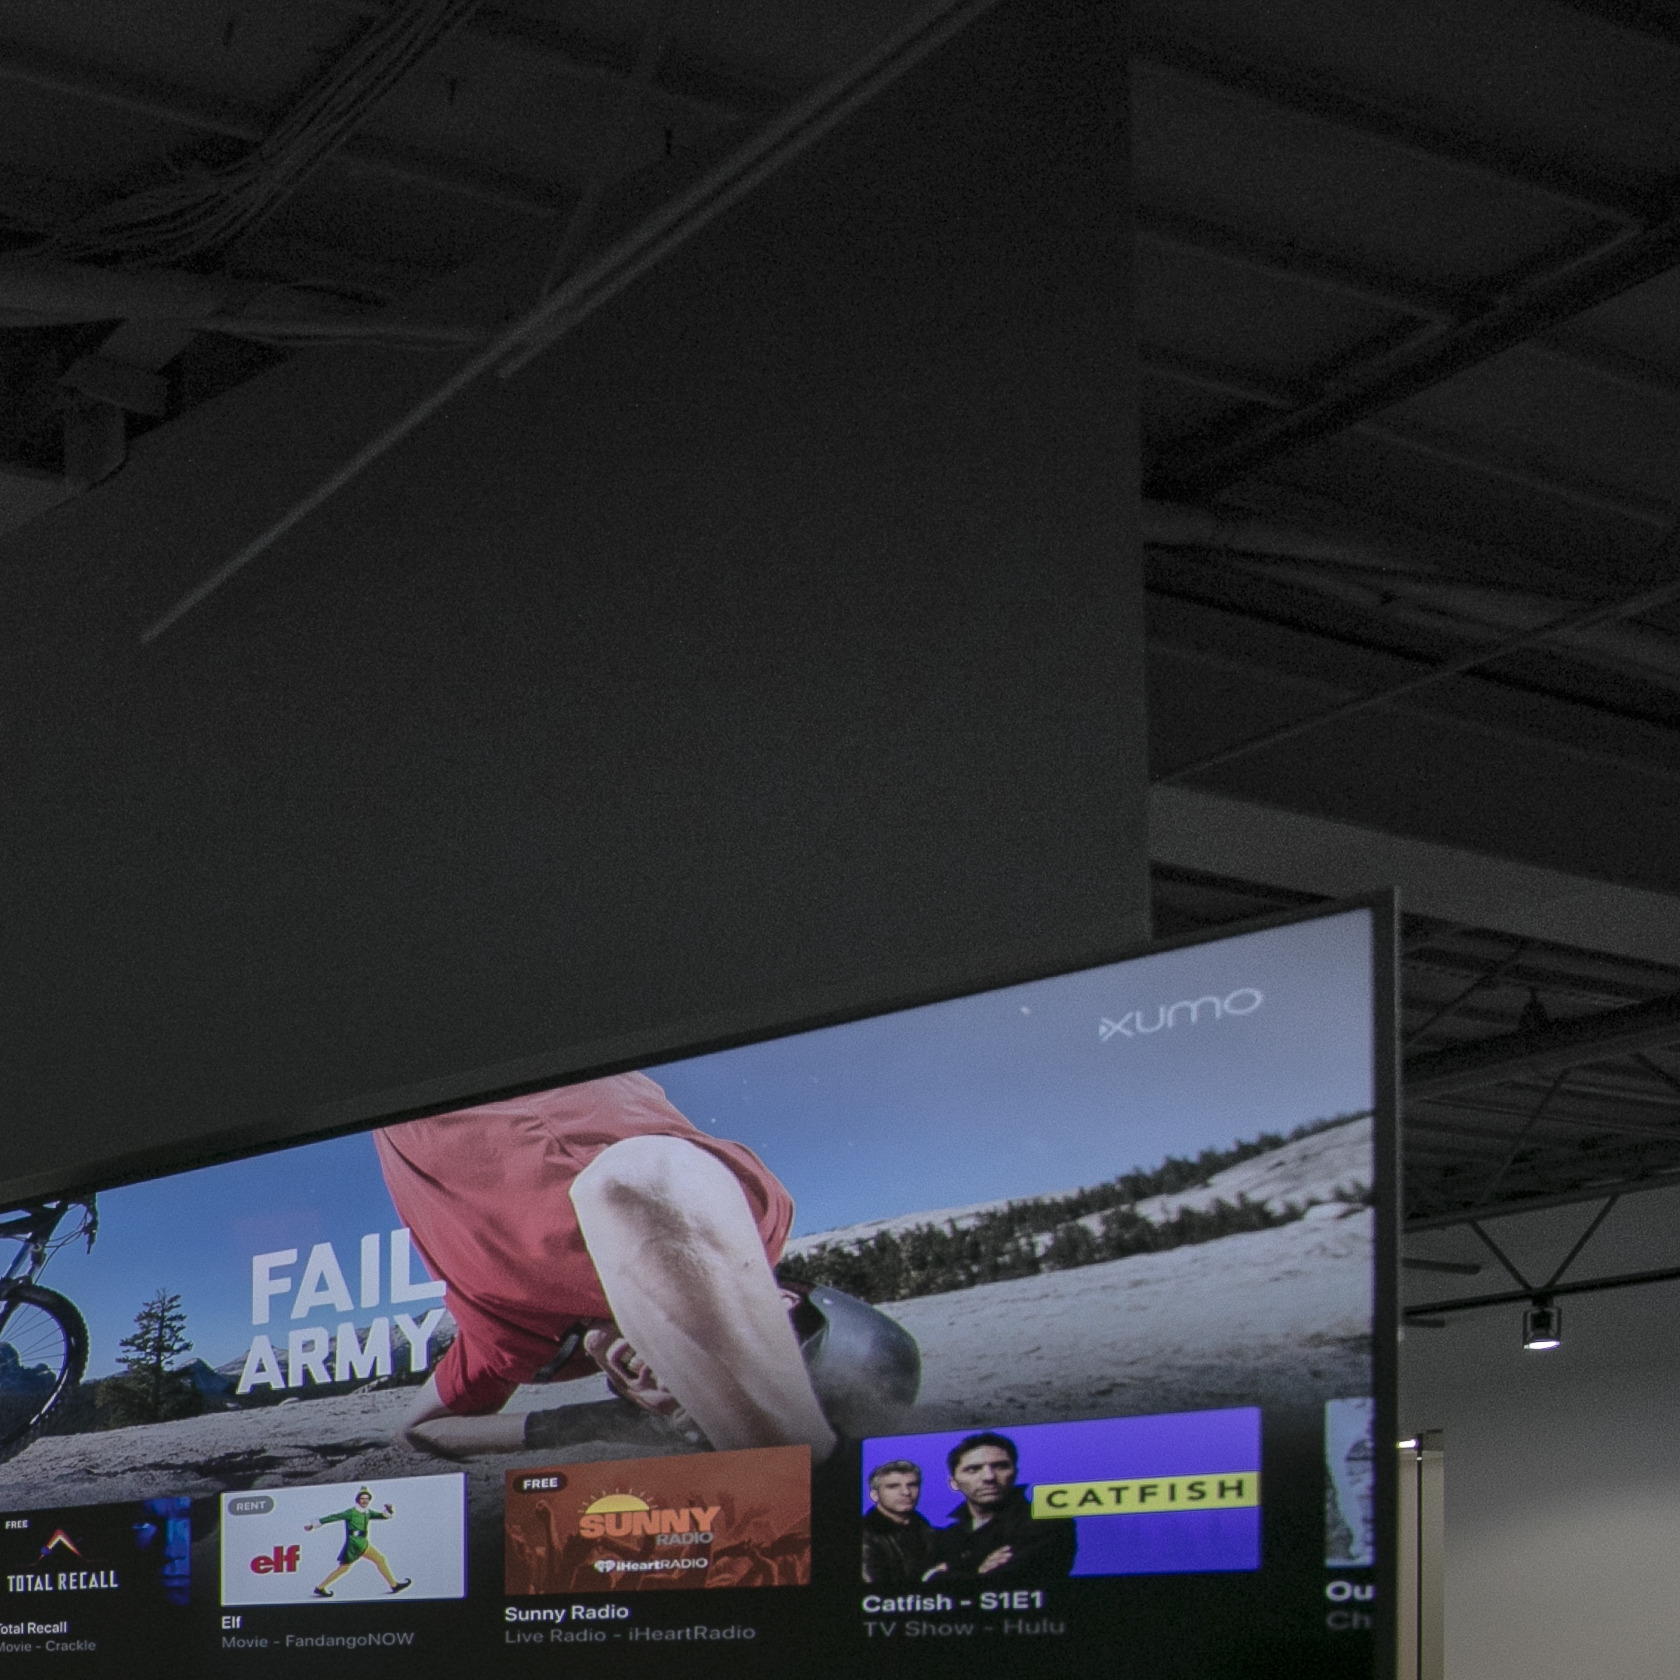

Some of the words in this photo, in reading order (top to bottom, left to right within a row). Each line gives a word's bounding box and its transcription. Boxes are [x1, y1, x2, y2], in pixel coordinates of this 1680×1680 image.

[252, 1227, 447, 1326] FAIL
[235, 1308, 446, 1396] ARMY
[523, 1477, 559, 1491] FREE
[1045, 1478, 1245, 1510] CATFISH
[236, 1500, 267, 1512] RENT
[5, 1519, 29, 1530] FREE
[579, 1505, 722, 1539] SUNNY
[656, 1531, 715, 1547] RADIO
[250, 1545, 301, 1575] elf
[616, 1558, 709, 1573] iHeartRADIO
[7, 1574, 53, 1592] TOTAL
[57, 1570, 120, 1591] RECALL
[862, 1594, 953, 1614] Catfish
[980, 1590, 1045, 1611] S1E1
[221, 1616, 242, 1630] Elf
[505, 1606, 566, 1624] Sunny
[571, 1604, 630, 1621] Radio
[27, 1621, 69, 1634] Recall
[505, 1629, 544, 1644] Live
[550, 1627, 607, 1643] Radio
[629, 1624, 757, 1642] iHeartRadio
[863, 1621, 897, 1639] TV
[905, 1618, 975, 1638] Show
[1004, 1617, 1067, 1636] Hulu
[45, 1639, 97, 1652] Crackle
[221, 1635, 269, 1649] Movie
[285, 1632, 416, 1650] FandangoNOW
